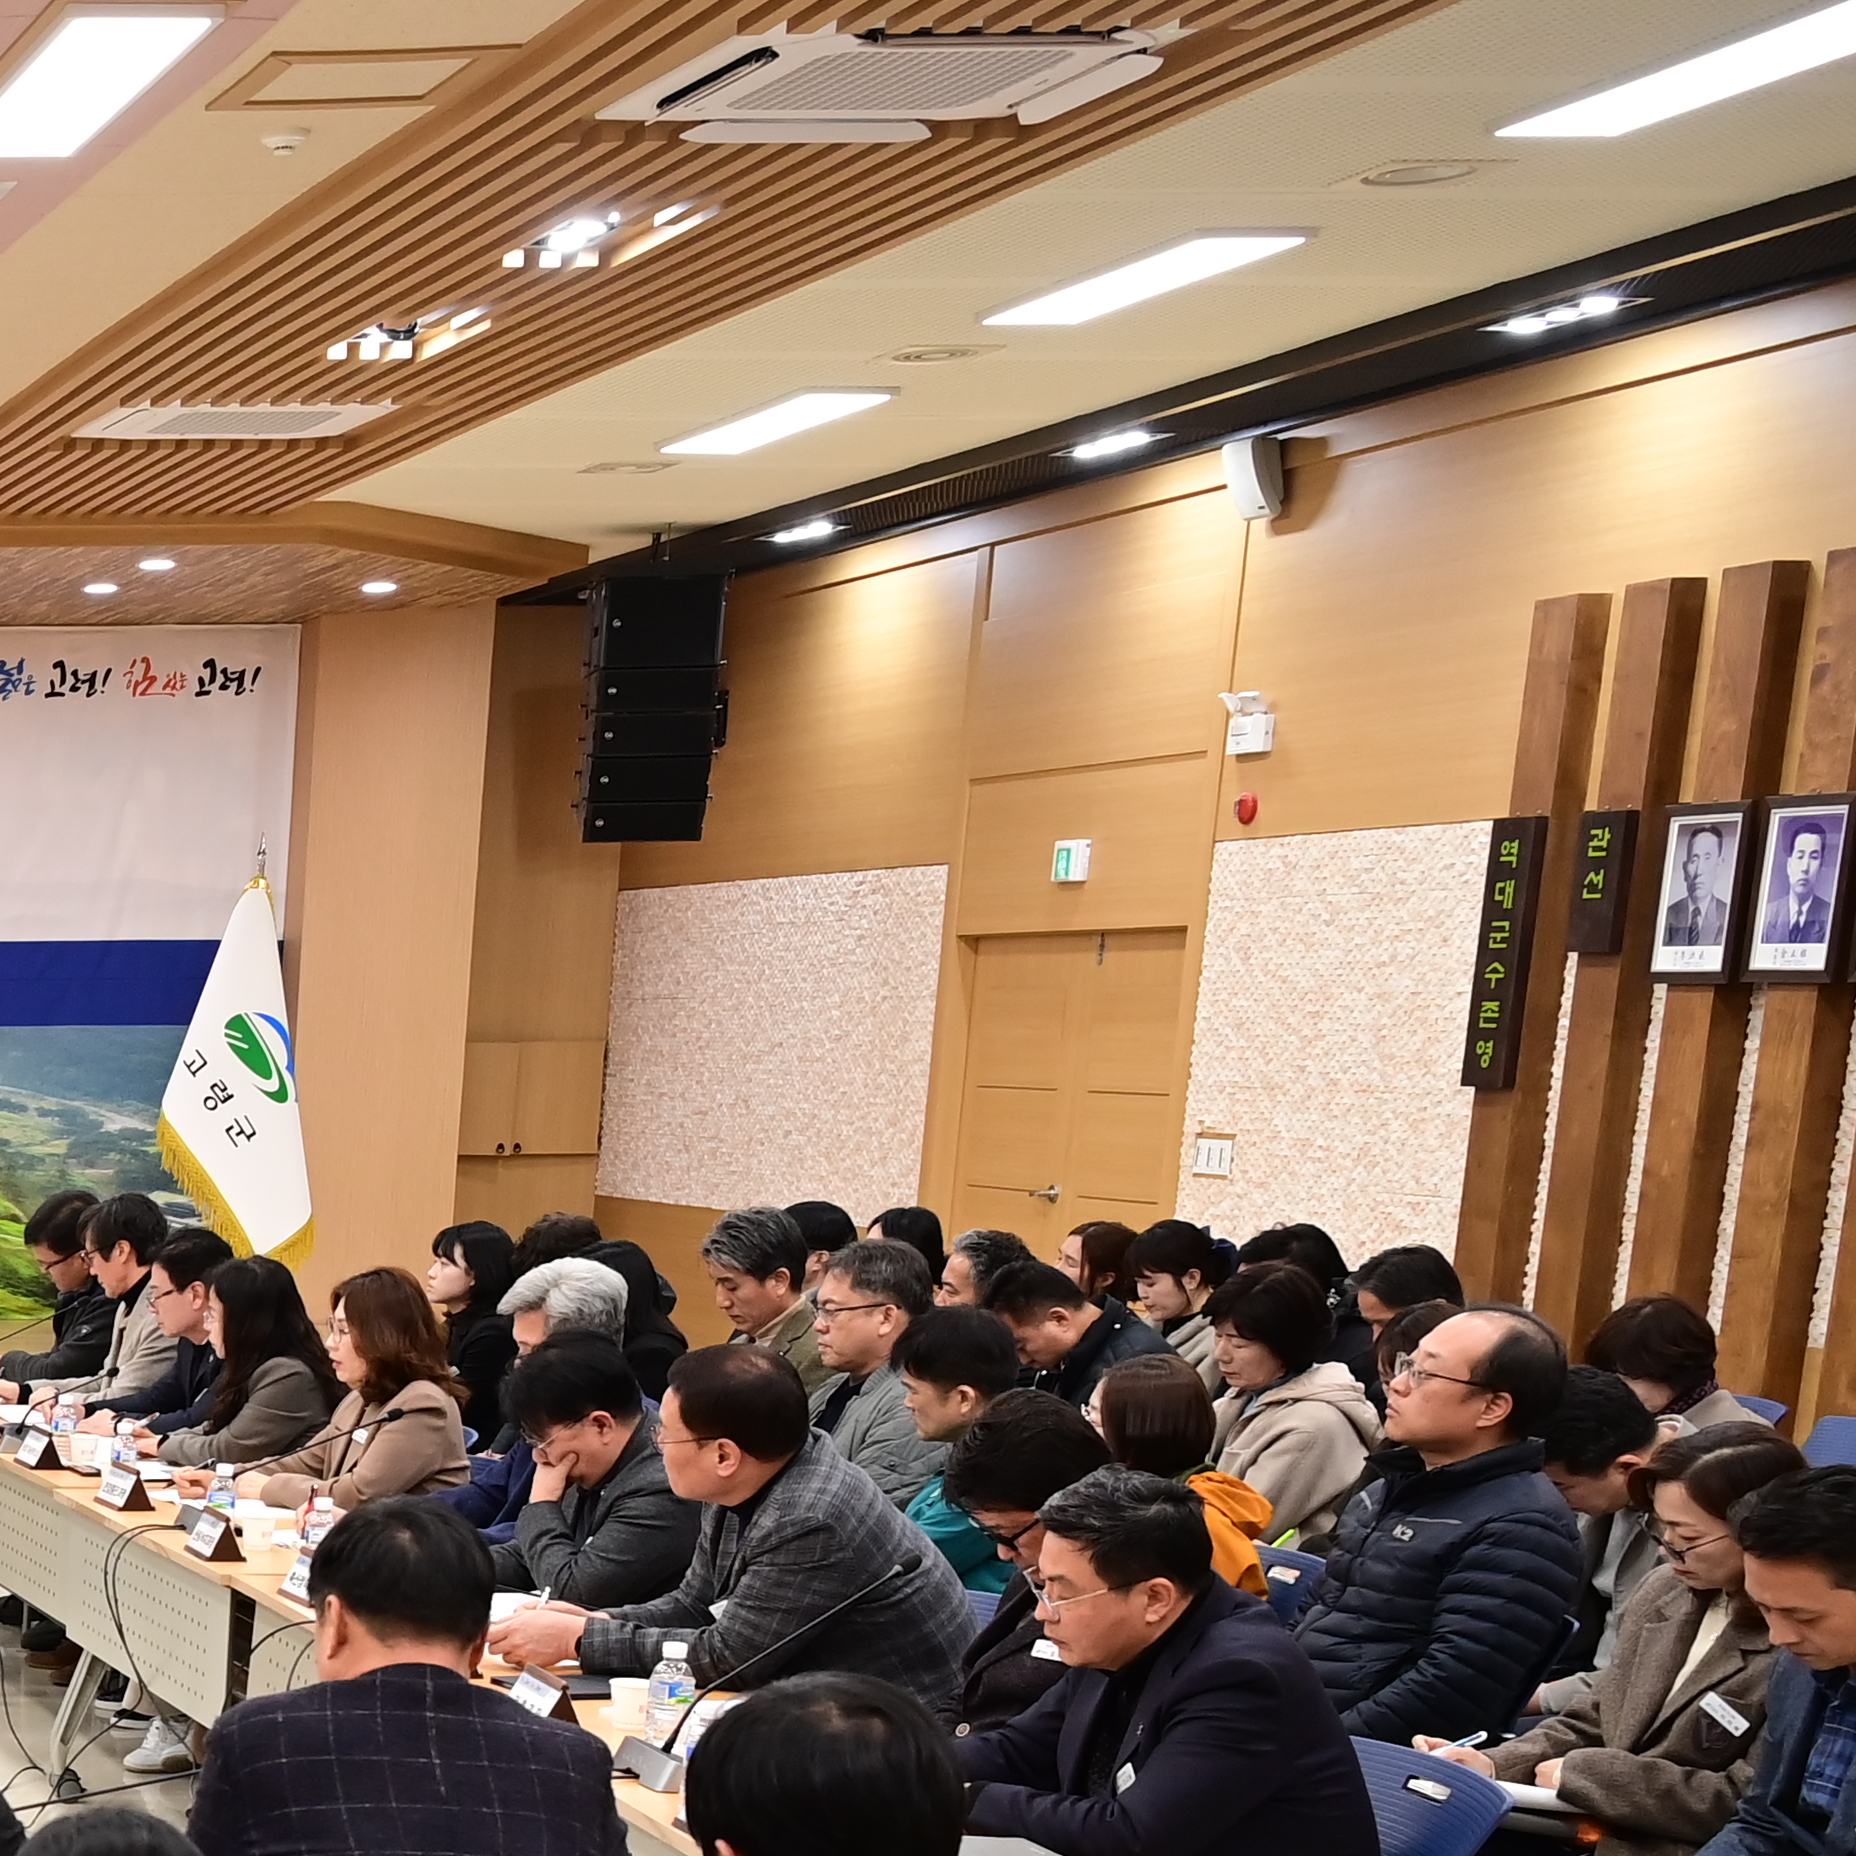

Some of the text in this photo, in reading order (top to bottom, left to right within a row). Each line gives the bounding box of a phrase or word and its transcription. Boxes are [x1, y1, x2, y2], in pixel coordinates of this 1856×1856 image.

[1581, 826, 1611, 899] 관선
[182, 1049, 257, 1149] 고령군
[1392, 1524, 1414, 1542] K2
